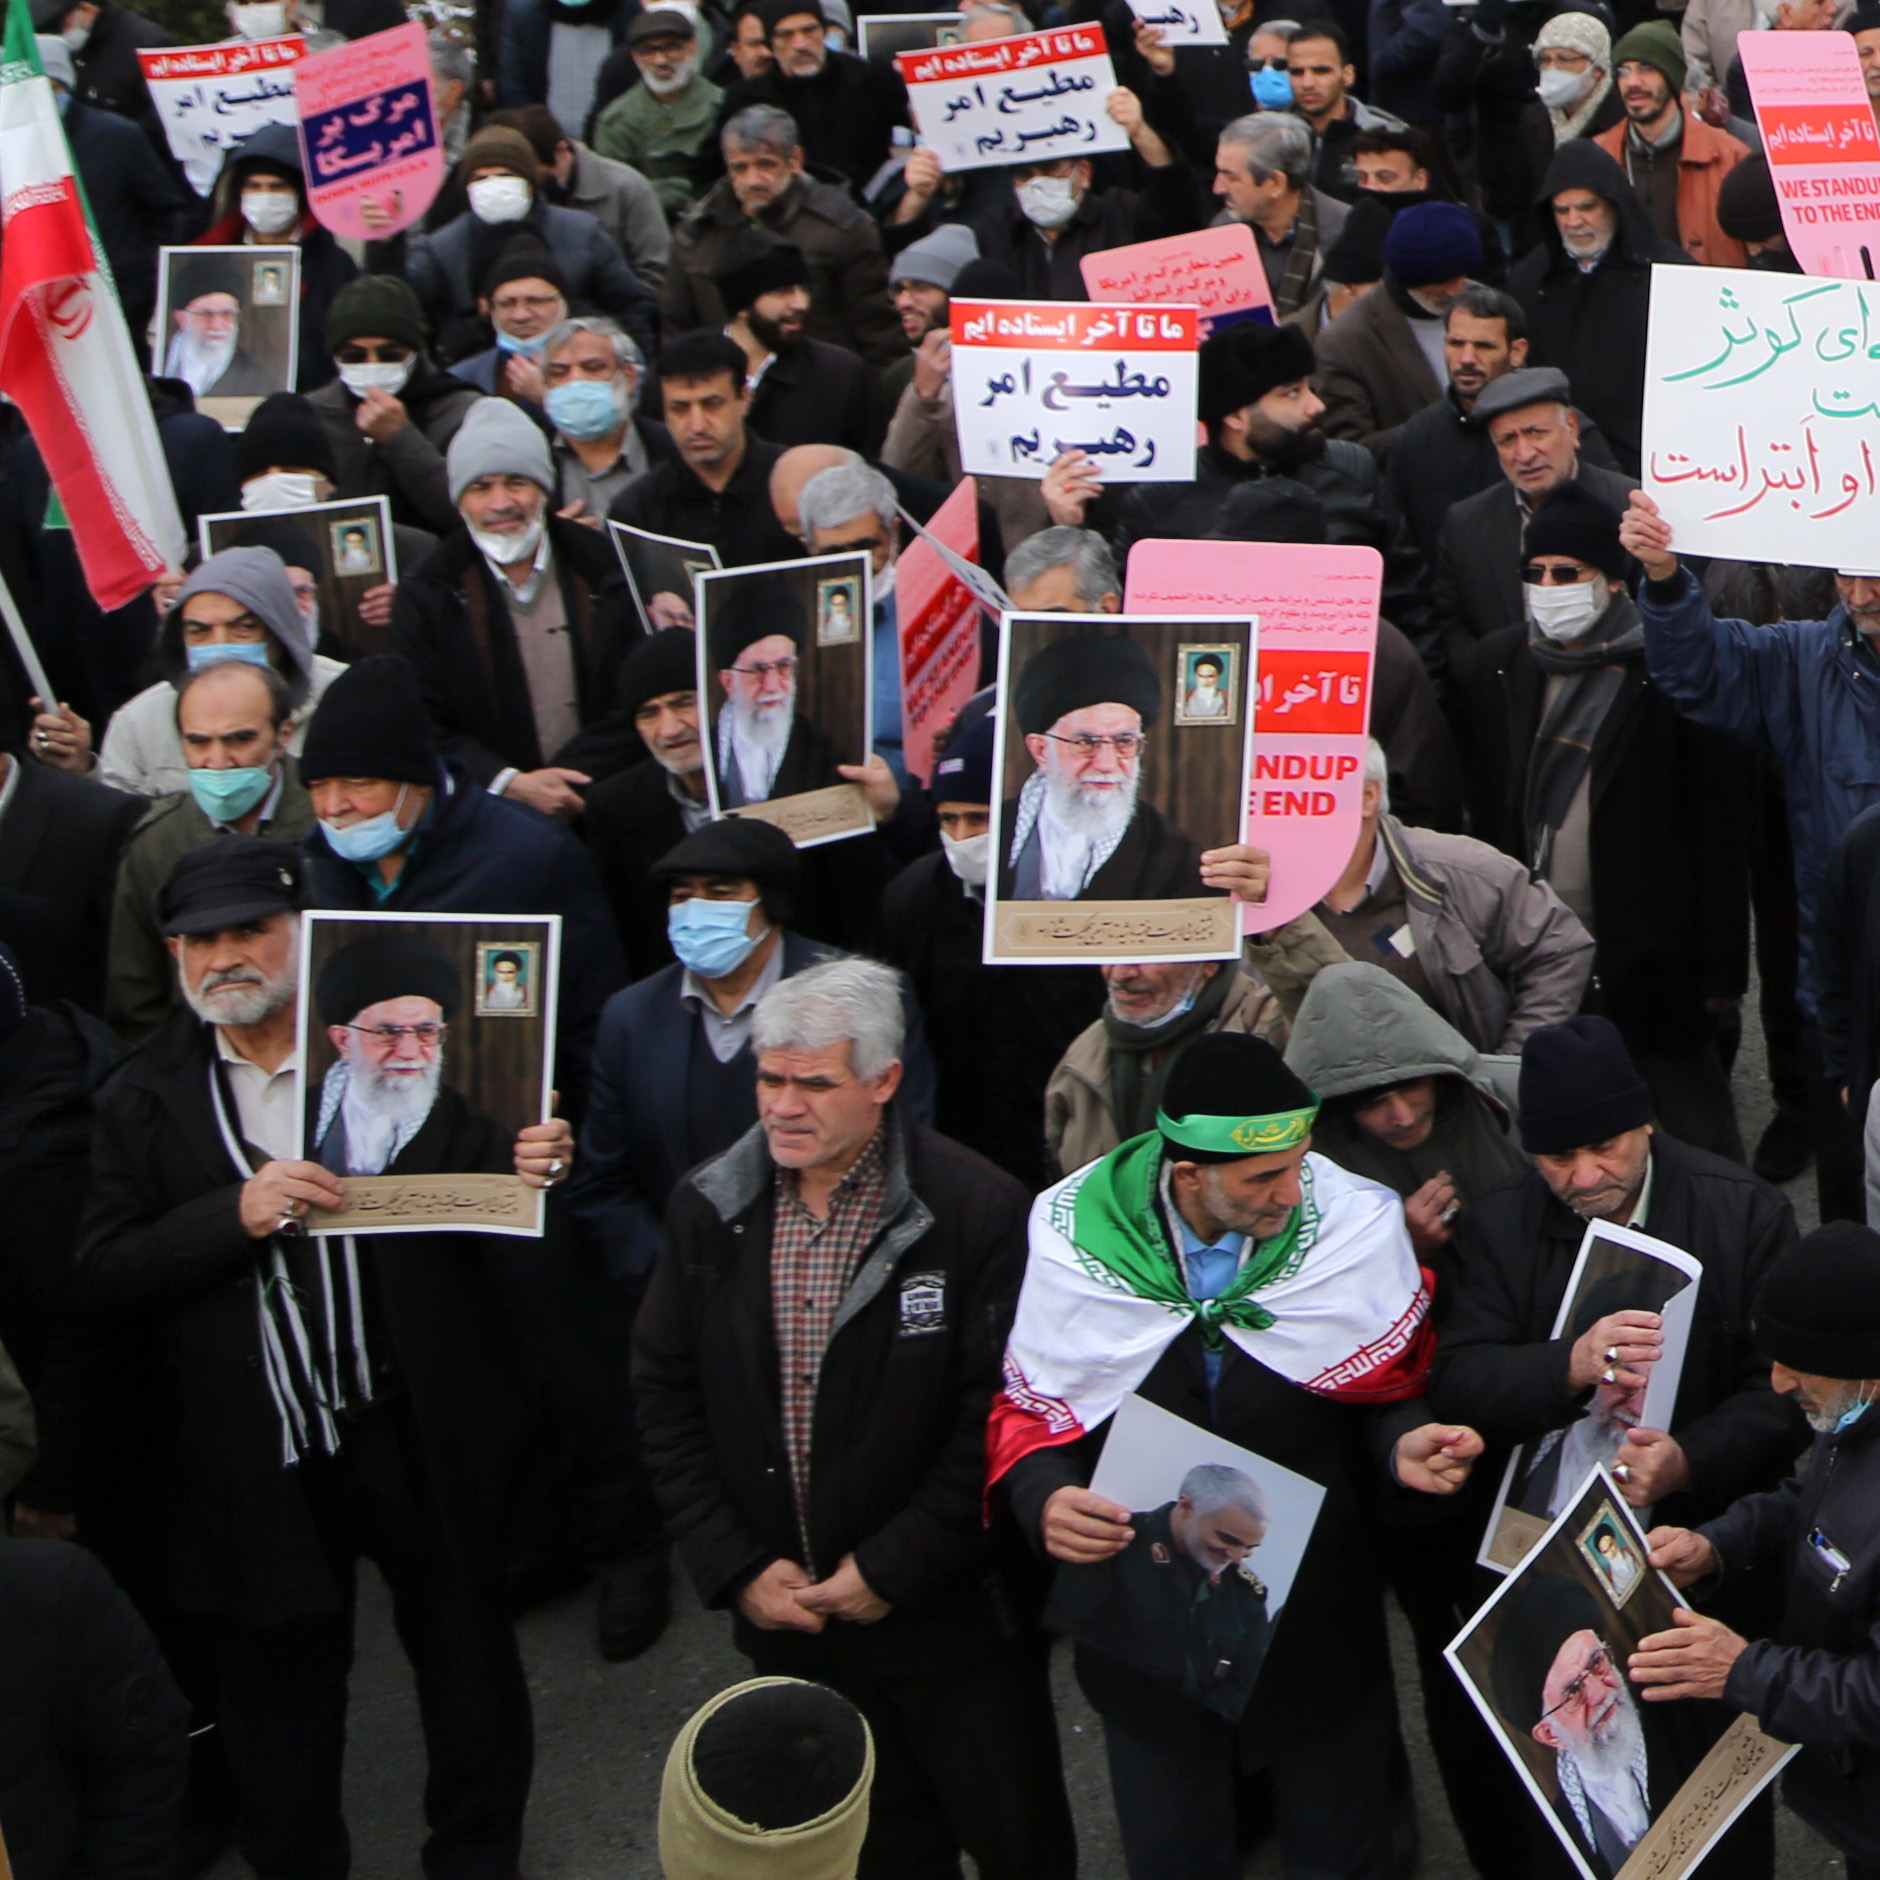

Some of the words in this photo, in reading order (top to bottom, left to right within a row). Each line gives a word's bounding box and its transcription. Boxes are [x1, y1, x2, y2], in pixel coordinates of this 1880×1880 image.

[942, 82, 984, 122] امر
[997, 68, 1095, 114] مطیع
[975, 115, 1096, 155] رهبریم
[1779, 179, 1810, 199] WE
[1791, 204, 1818, 224] TO
[1819, 203, 1854, 223] THE
[963, 310, 995, 341] ایم
[998, 312, 1076, 343] ایستاده
[1079, 310, 1133, 345] آخر
[1136, 314, 1155, 339] تا
[1159, 312, 1184, 339] ما
[1661, 283, 1842, 390] کوثر
[978, 356, 1030, 406] امر
[1041, 357, 1171, 410] مطیع
[1651, 425, 1749, 491] است
[1808, 439, 1875, 519] او
[1274, 671, 1338, 714] آخر
[1338, 675, 1362, 705] تا
[1263, 791, 1337, 816] END
